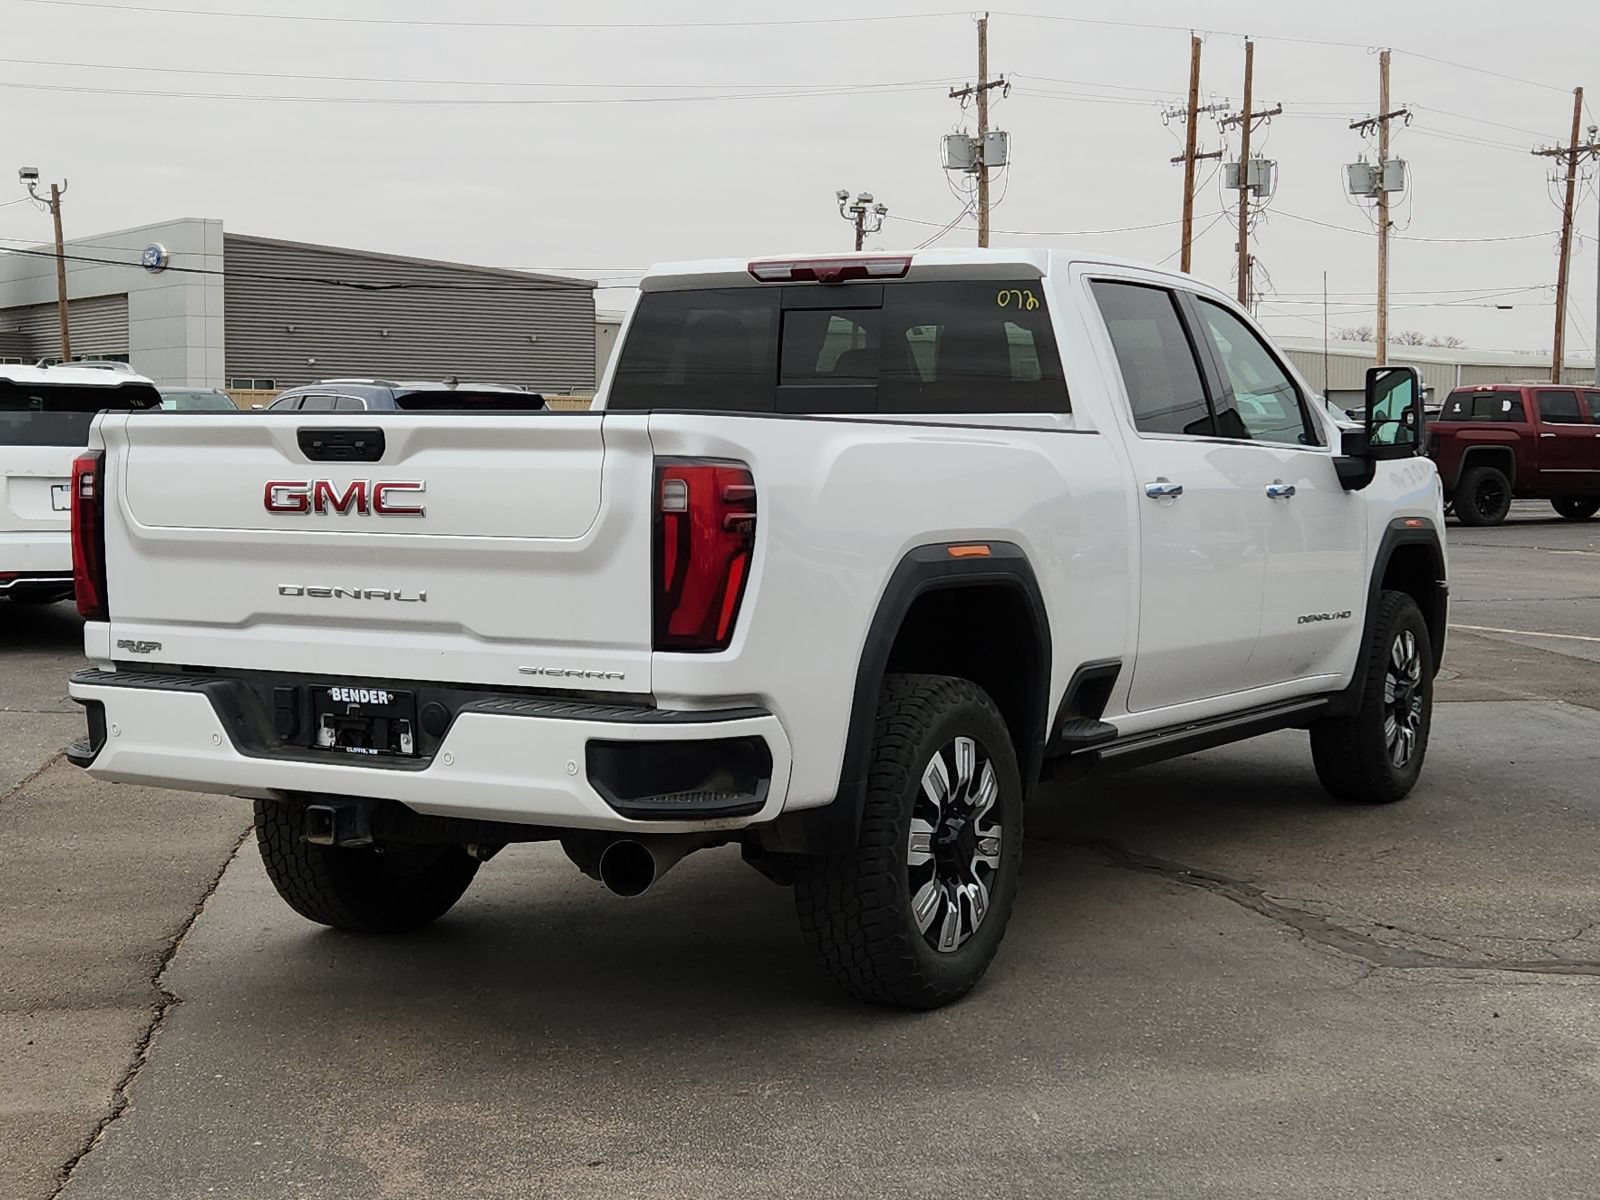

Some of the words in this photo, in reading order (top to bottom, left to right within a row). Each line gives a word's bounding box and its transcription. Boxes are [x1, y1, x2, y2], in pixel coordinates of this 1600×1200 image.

[997, 289, 1039, 311] 072
[264, 479, 426, 518] GMC
[278, 583, 427, 602] DENALI
[1297, 612, 1335, 625] DENALI
[1336, 610, 1352, 620] HD
[518, 665, 626, 680] SIERRA
[331, 687, 389, 705] BENDER
